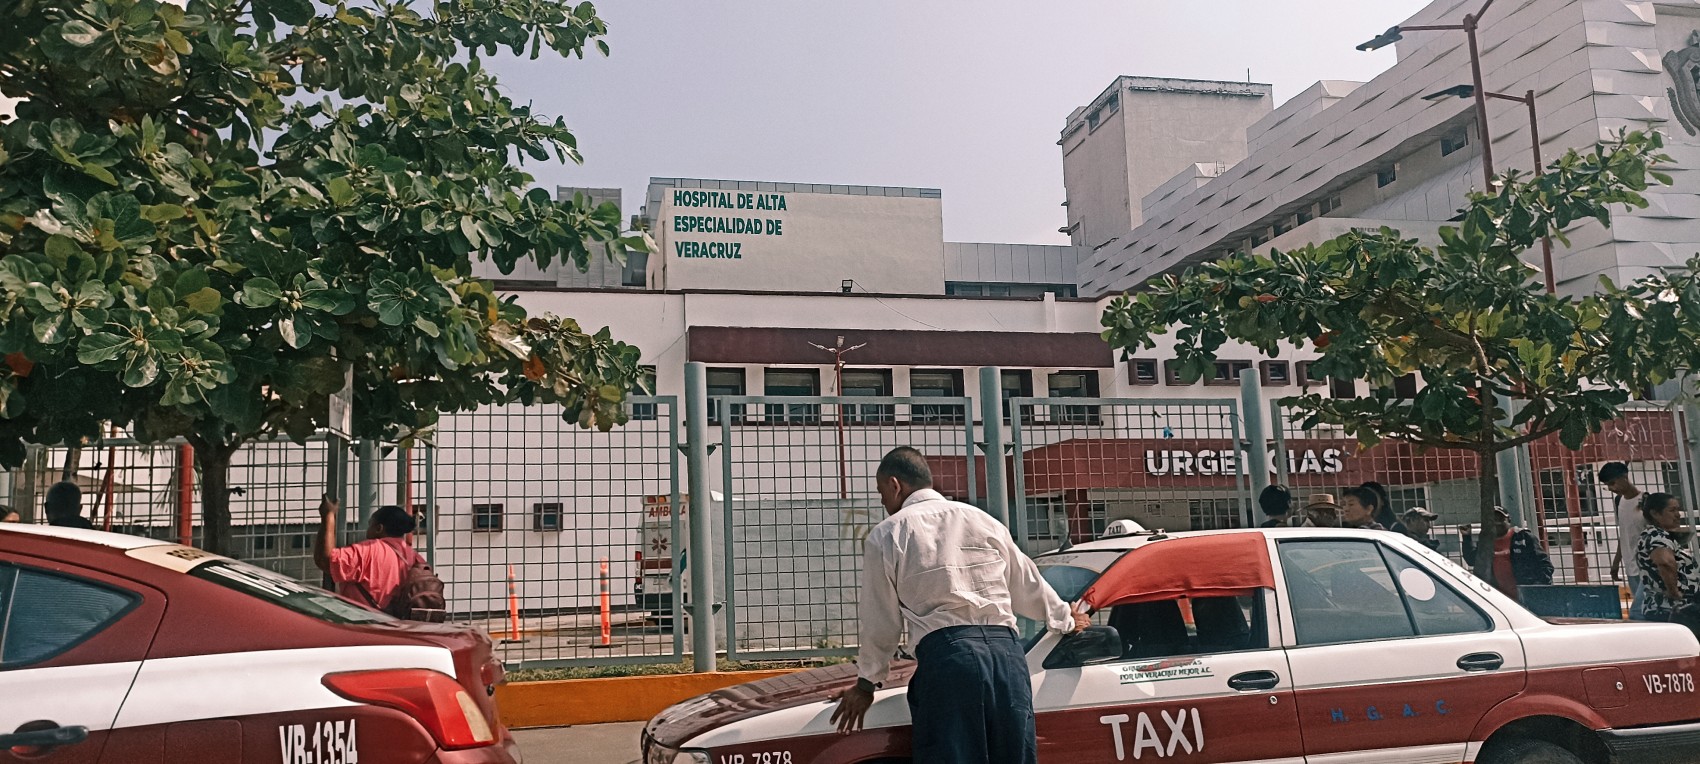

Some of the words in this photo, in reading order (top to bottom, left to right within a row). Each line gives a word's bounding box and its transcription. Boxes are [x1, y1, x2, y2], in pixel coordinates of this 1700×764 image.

[673, 190, 734, 209] HOSPITAL
[737, 193, 754, 210] DE
[756, 194, 787, 211] ALTA
[674, 216, 763, 235] ESPECIALIDAD
[766, 219, 782, 236] DE
[675, 241, 742, 259] VERACRUZ
[1108, 525, 1122, 536] TAXI
[1120, 673, 1134, 681] POR
[1144, 669, 1177, 678] VERACRUZ
[1178, 667, 1200, 676] MEJOR
[1642, 673, 1695, 694] VB-7878
[278, 718, 358, 764] VB-1354
[1099, 707, 1205, 761] TAXI
